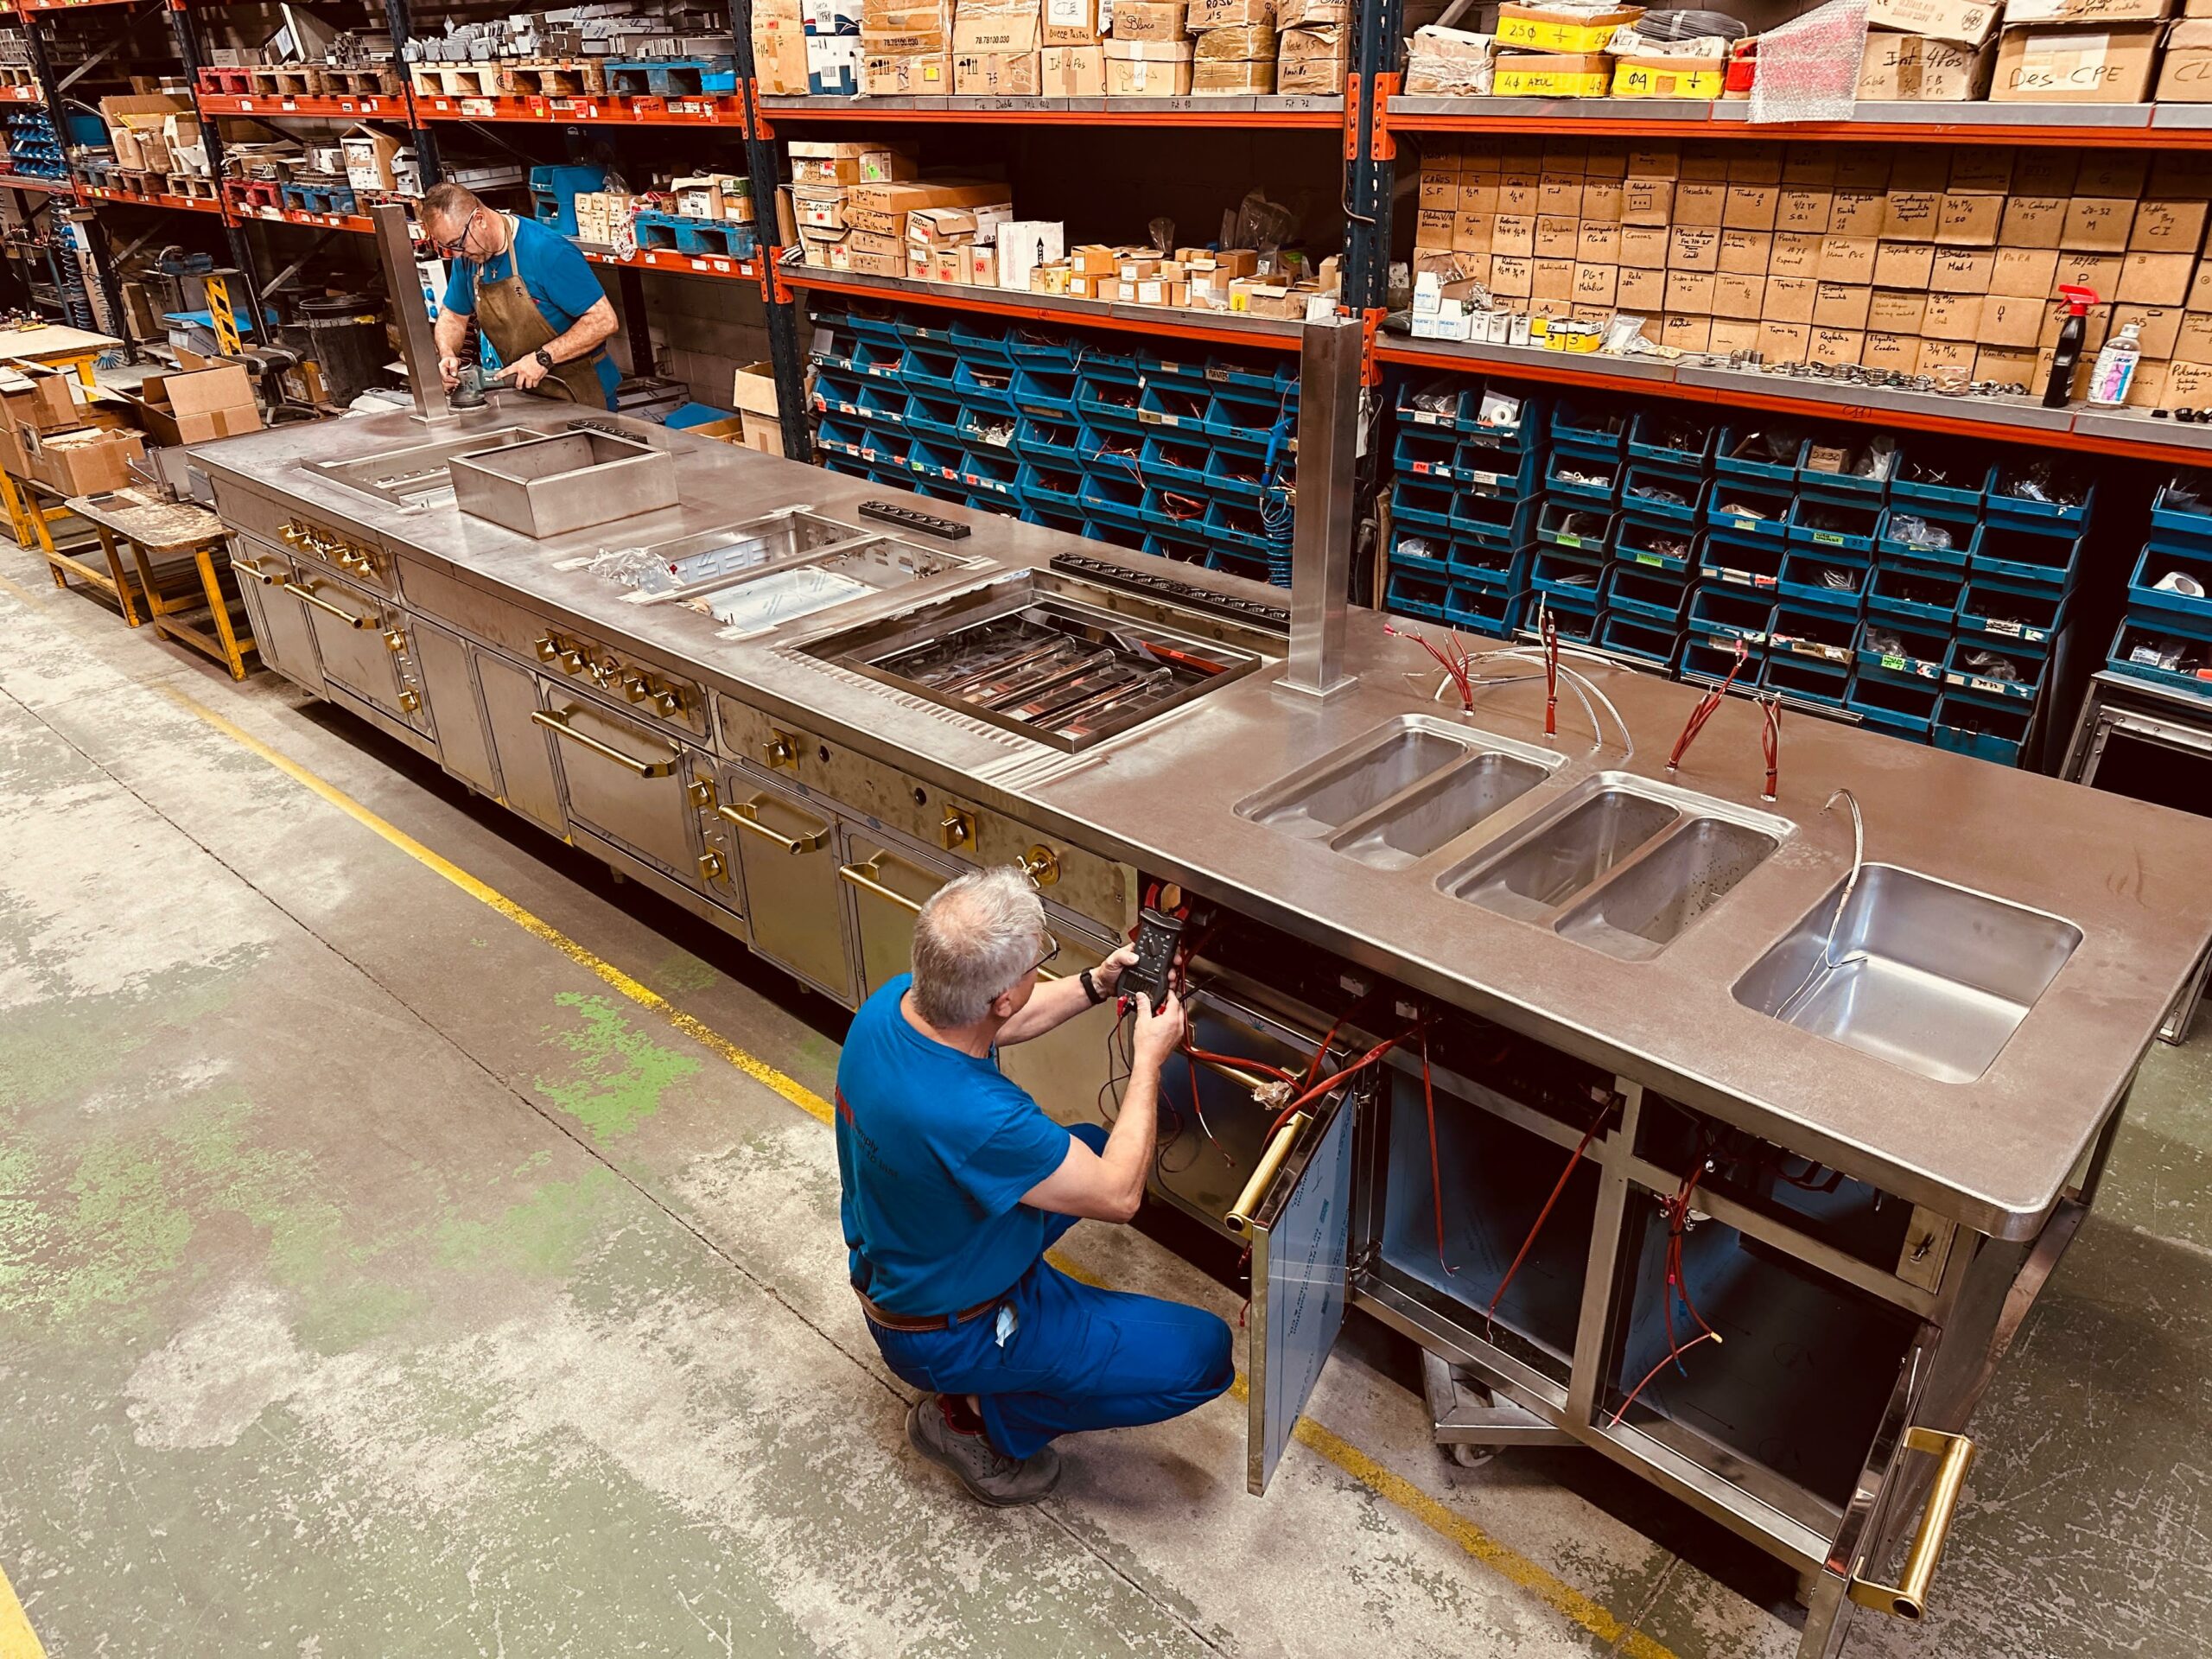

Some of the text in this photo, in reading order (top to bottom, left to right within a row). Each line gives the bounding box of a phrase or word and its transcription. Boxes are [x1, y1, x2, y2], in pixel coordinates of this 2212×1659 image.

[975, 35, 1010, 44] 78.78100.030
[2071, 67, 2124, 83] CPE
[1528, 78, 1553, 88] AZUL
